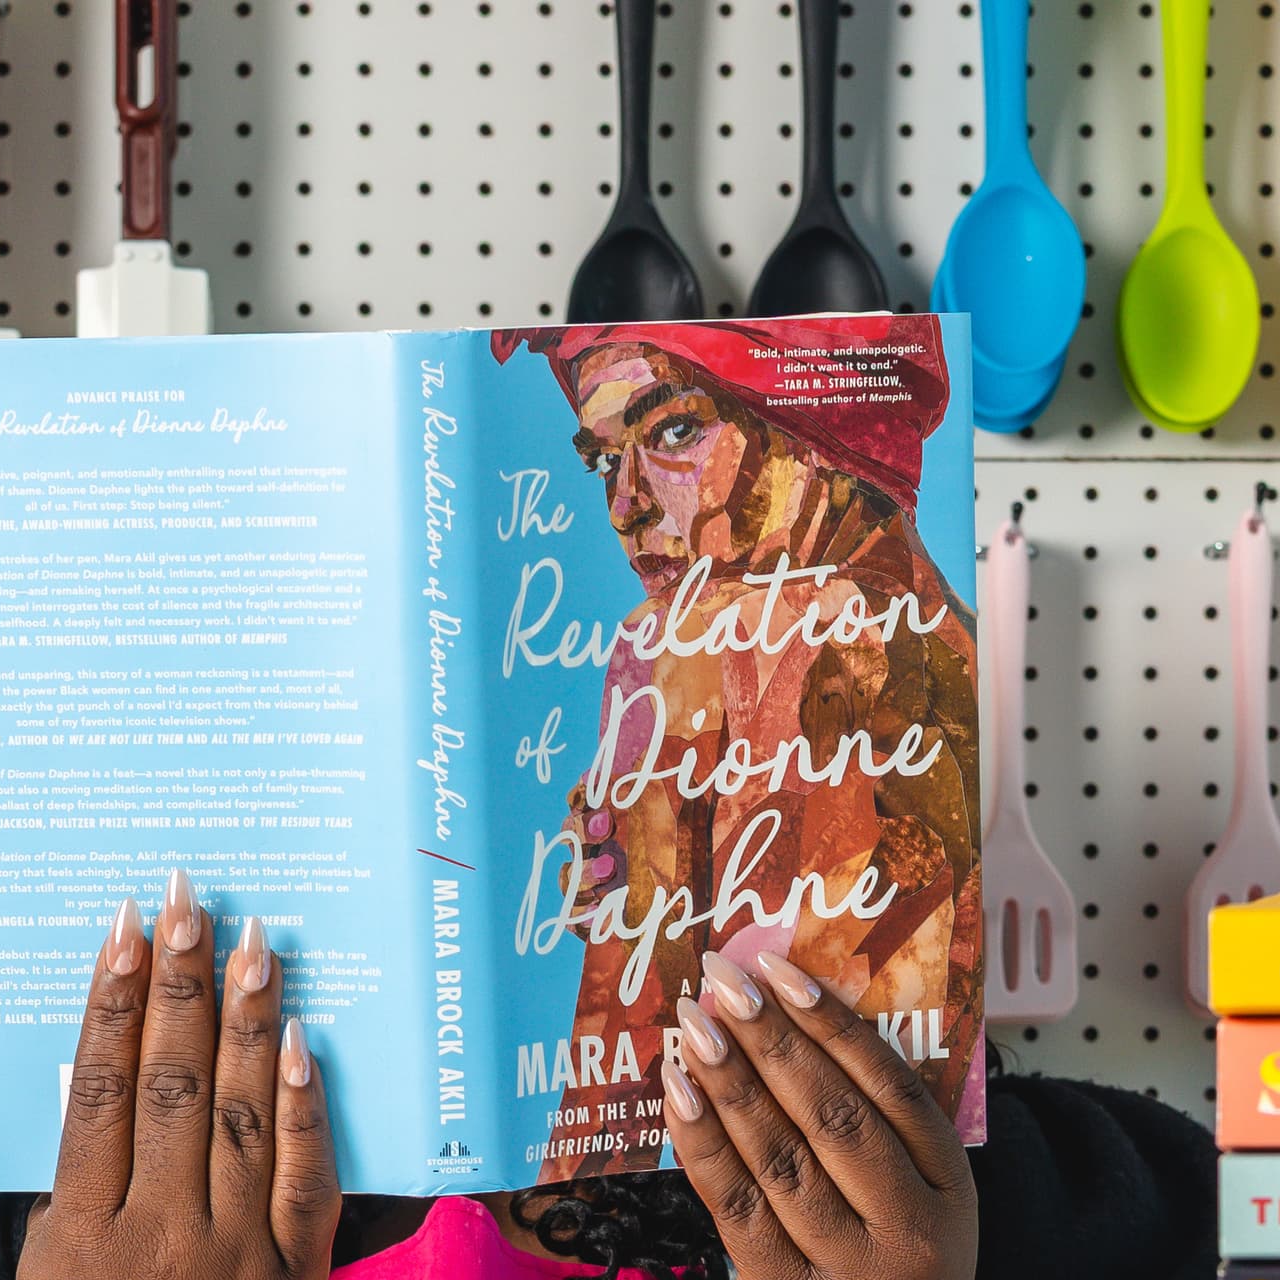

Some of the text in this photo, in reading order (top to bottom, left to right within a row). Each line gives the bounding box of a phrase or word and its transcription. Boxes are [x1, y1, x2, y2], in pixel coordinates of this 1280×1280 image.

[748, 342, 926, 360] "Bold, intimate, and unapologetic.
[776, 359, 898, 373] I didn't want it to end."
[774, 375, 905, 390] —TARA M. STRINGFELLOW,
[66, 390, 185, 404] ADVANCE PRAISE FOR
[766, 391, 912, 407] bestselling author of Memphis
[109, 418, 126, 438] of
[131, 407, 205, 434] Dionne
[210, 406, 288, 440] Daphne
[497, 469, 575, 542] The
[416, 360, 467, 841] The Revelation of Dionne Daphne
[503, 552, 949, 679] Revelation
[18, 635, 32, 647] M.
[34, 634, 112, 648] STRINGFELLOW,
[114, 633, 177, 646] BESTSELLING
[180, 633, 221, 645] AUTHOR
[224, 633, 238, 645] OF
[240, 632, 287, 644] MEMPHIS
[516, 706, 567, 783] of
[587, 683, 941, 809] Dionne
[32, 799, 44, 810] of
[46, 800, 75, 813] deep
[76, 799, 140, 812] friendships,
[142, 799, 164, 809] and
[165, 799, 232, 811] complicated
[233, 798, 304, 811] forgiveness."
[49, 817, 96, 829] PULITZER
[98, 817, 128, 828] PRIZE
[130, 817, 171, 828] WINNER
[174, 817, 196, 828] AND
[198, 816, 240, 828] AUTHOR
[242, 816, 256, 828] OF
[260, 816, 278, 828] THE
[280, 816, 320, 827] RESIDUE
[324, 817, 352, 828] YEARS
[515, 808, 899, 1007] Daphne
[680, 978, 692, 996] A
[431, 879, 467, 1125] MARA BROCK AKIL
[517, 1030, 642, 1098] MARA
[860, 1009, 950, 1062] KIL
[547, 1105, 590, 1129] FROM
[597, 1101, 628, 1122] THE
[525, 1132, 631, 1163] GIRLFRIENDS,
[426, 1156, 484, 1167] STOREHOUSE
[440, 1165, 472, 1175] VOICES
